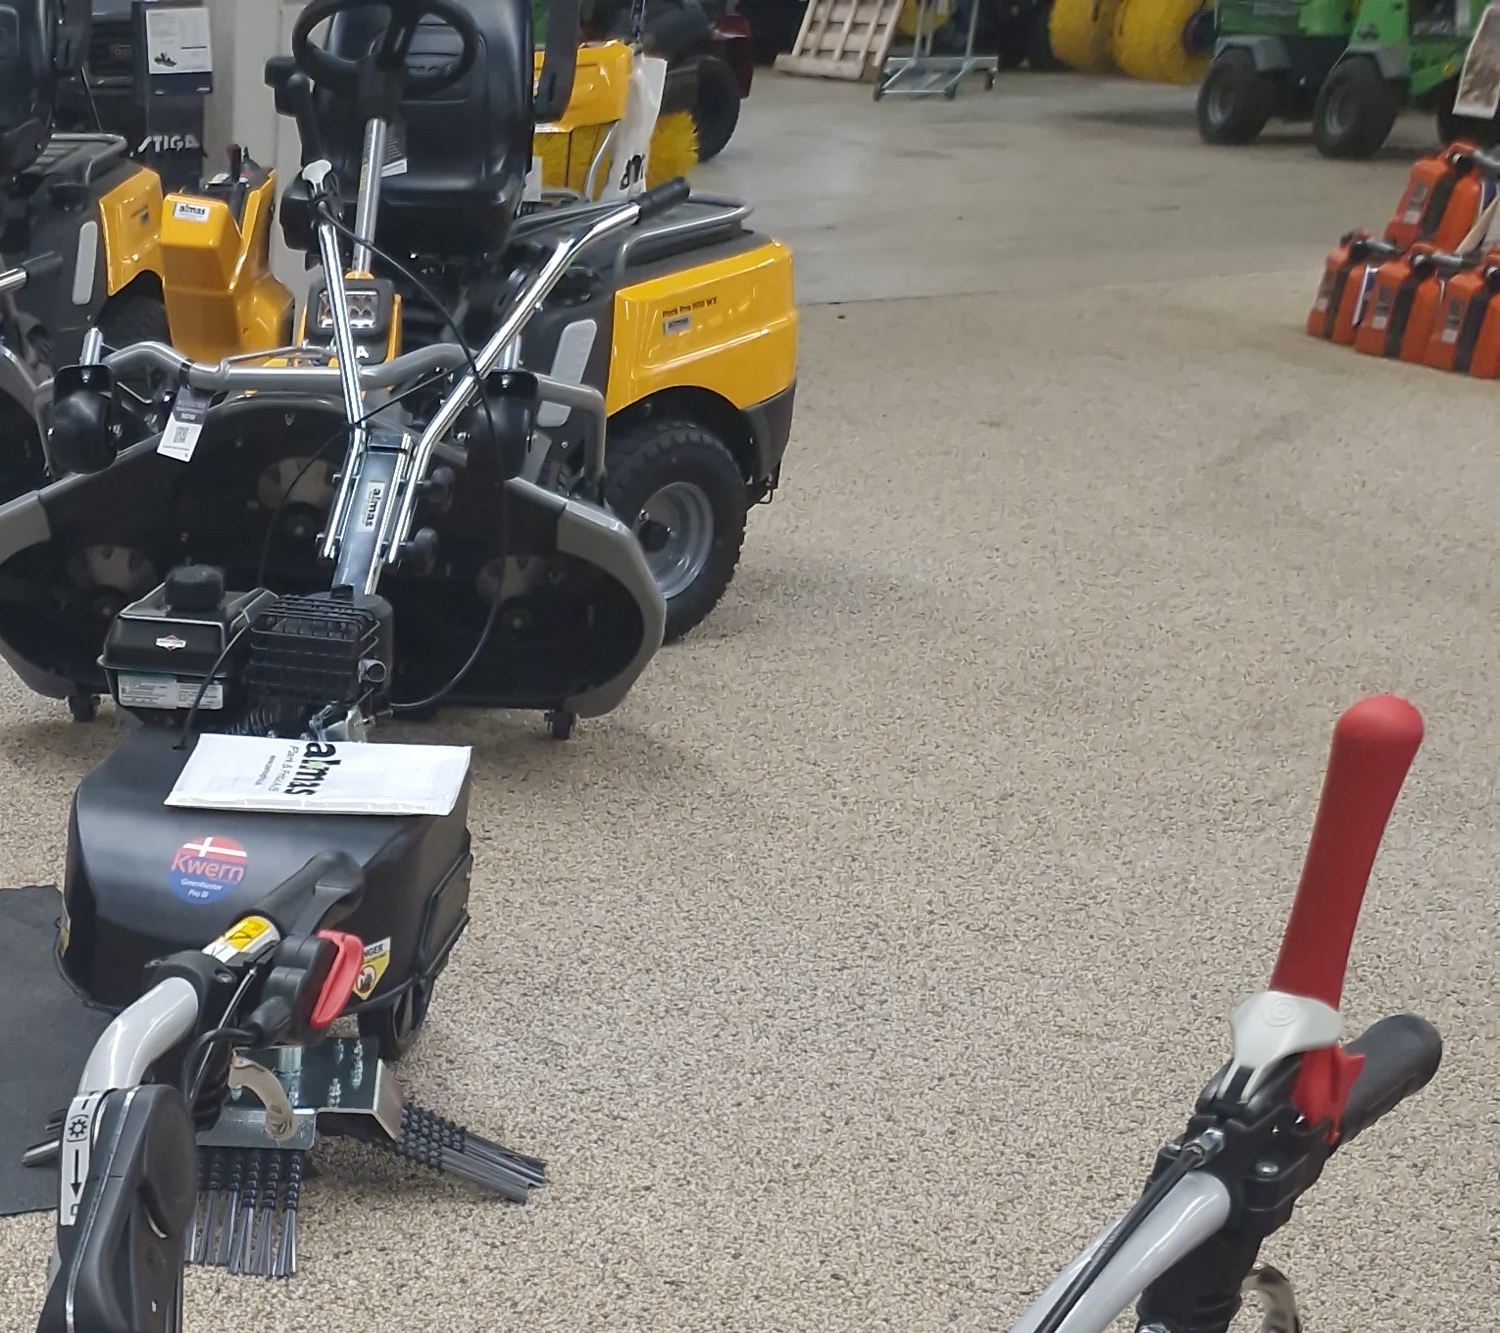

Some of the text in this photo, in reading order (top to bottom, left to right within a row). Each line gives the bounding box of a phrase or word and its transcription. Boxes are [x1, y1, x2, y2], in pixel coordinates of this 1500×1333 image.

[138, 135, 200, 152] STIGA
[178, 204, 206, 216] almas
[365, 488, 381, 528] almas
[283, 742, 341, 796] almas
